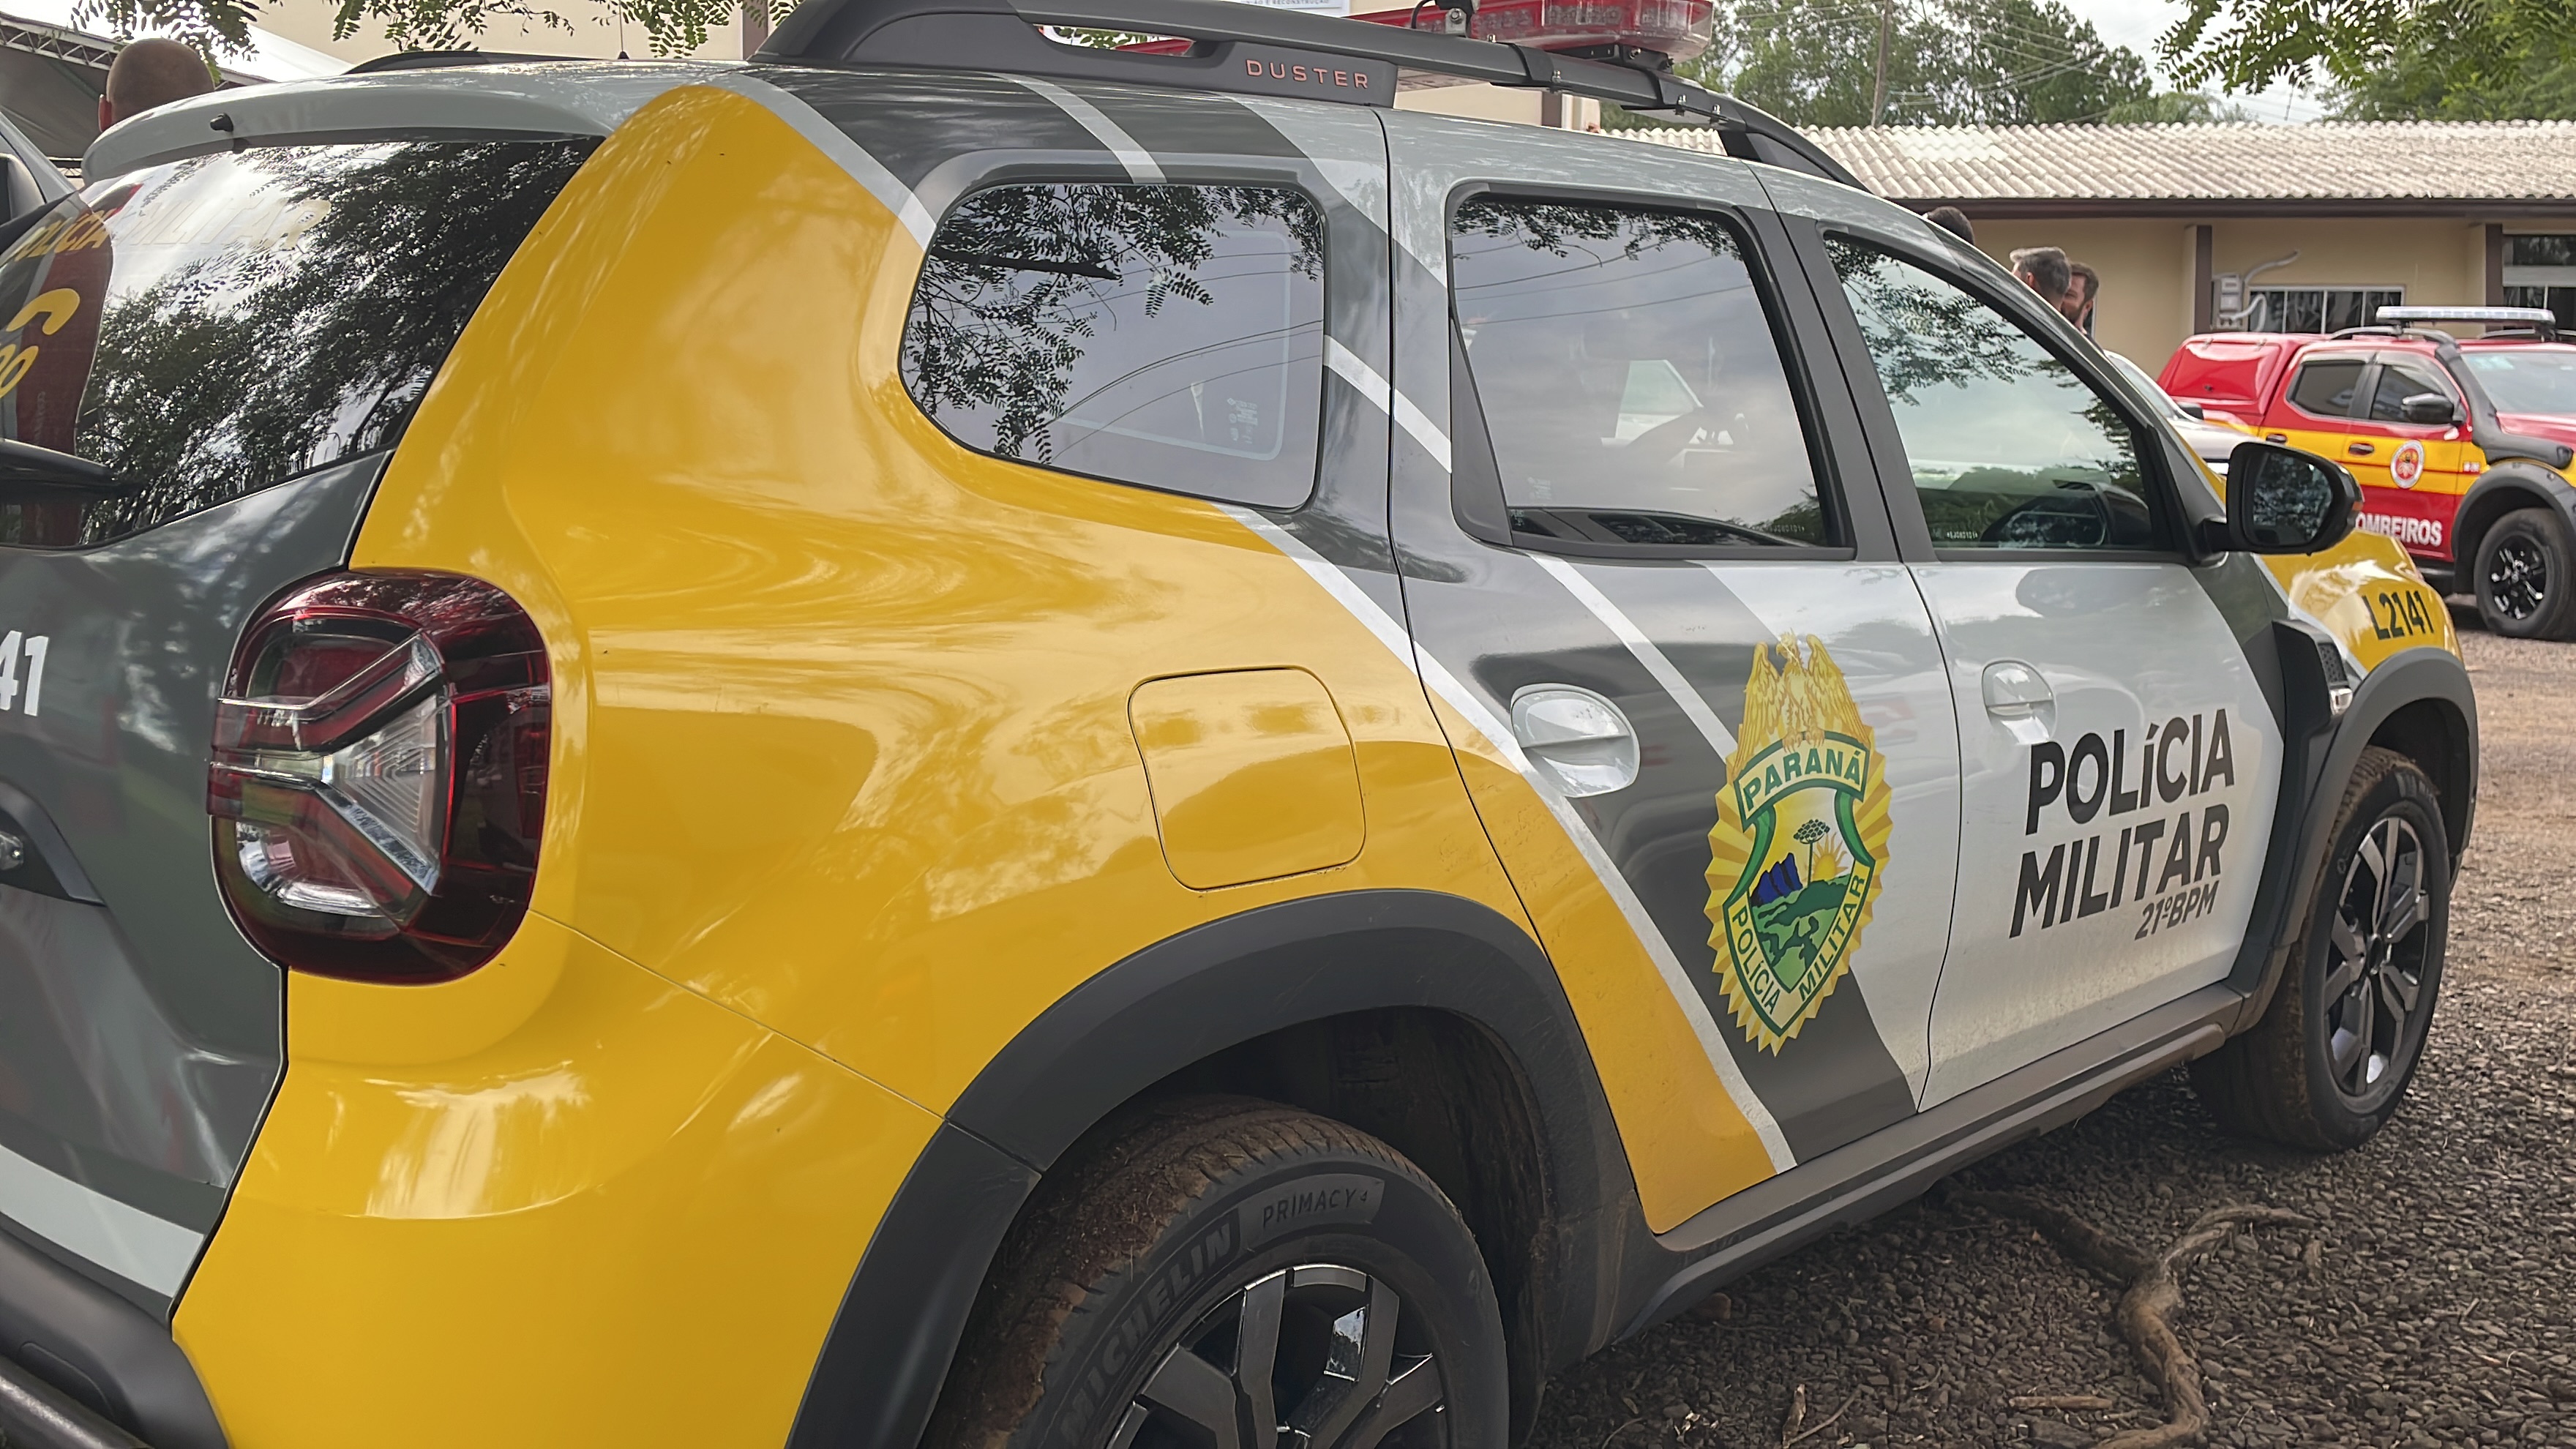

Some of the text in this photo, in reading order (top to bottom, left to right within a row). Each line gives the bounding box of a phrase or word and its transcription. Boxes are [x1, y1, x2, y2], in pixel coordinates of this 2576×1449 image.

[1246, 59, 1368, 89] DUSTER
[2355, 511, 2443, 547] OMBEIROS
[2362, 589, 2435, 641] L2141
[1742, 748, 1861, 812] PARANÁ
[2025, 708, 2235, 836] POLÍCIA
[2009, 803, 2230, 940] MILITAR
[1731, 875, 1865, 1015] POLÍCIA MILITAR
[1263, 1188, 1357, 1229] PRIMACY
[1060, 1222, 1232, 1448] MICHELIN
